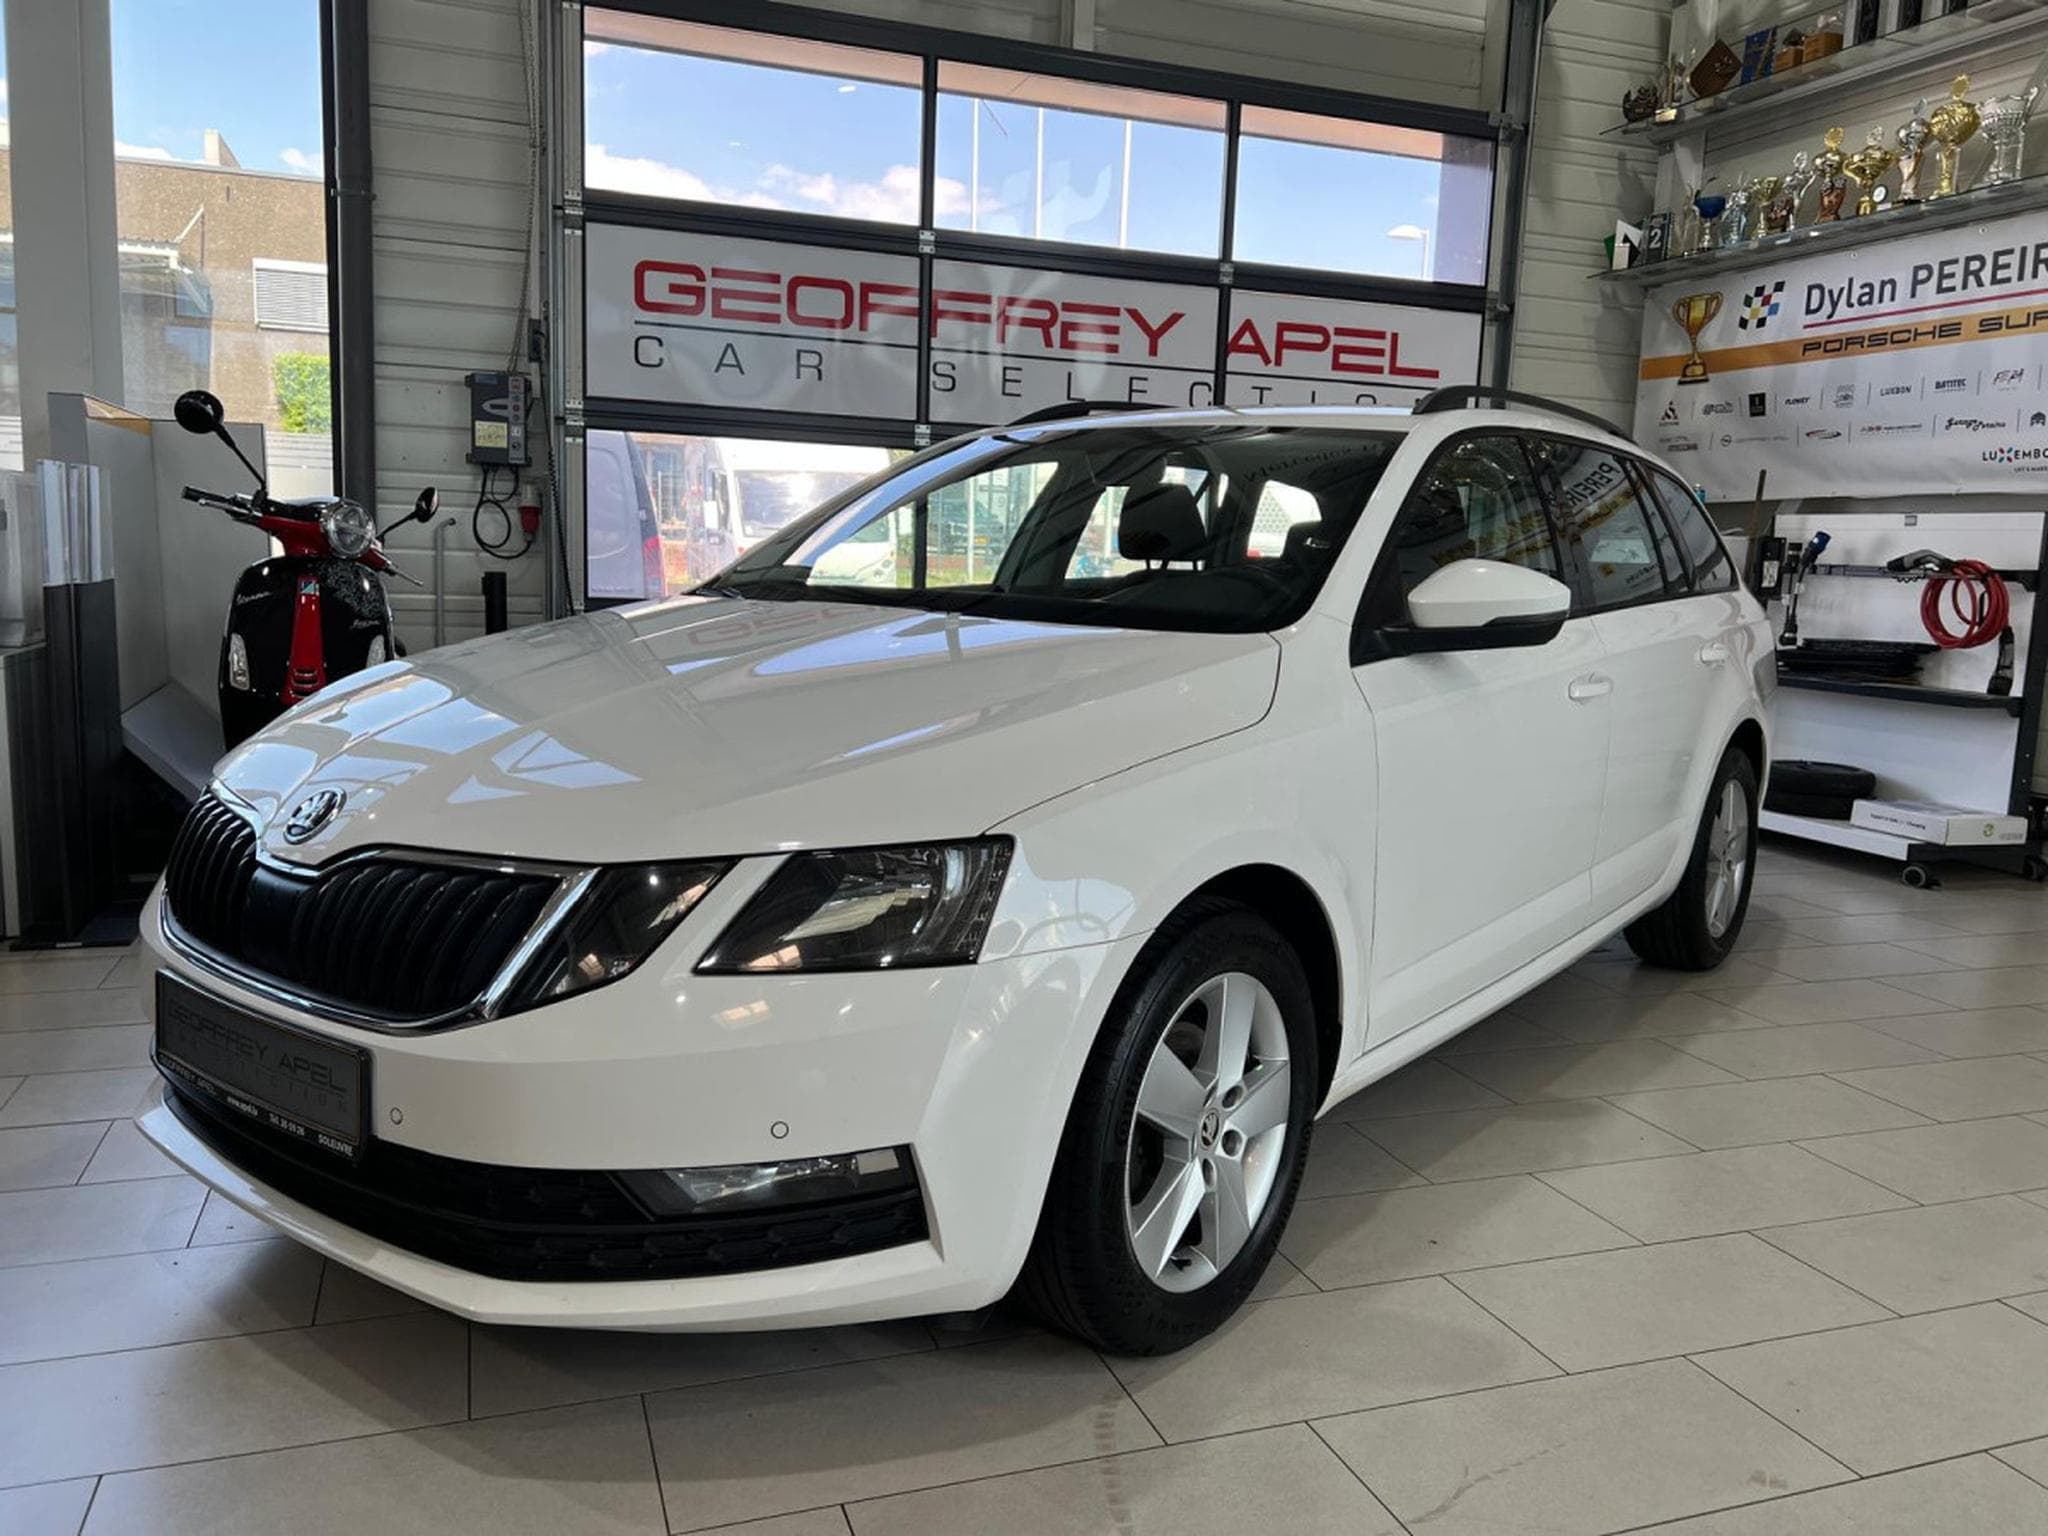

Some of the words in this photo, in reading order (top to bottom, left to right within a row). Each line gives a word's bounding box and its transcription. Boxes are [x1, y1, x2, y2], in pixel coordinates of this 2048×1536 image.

[1649, 228, 1662, 249] 2
[1805, 277, 1897, 319] Dylan
[634, 260, 1186, 358] GEOFFREY
[1227, 318, 1440, 379] APEL
[1802, 321, 1962, 357] PORSCHE
[634, 335, 823, 381] CAR
[932, 361, 1422, 406] SELECT
